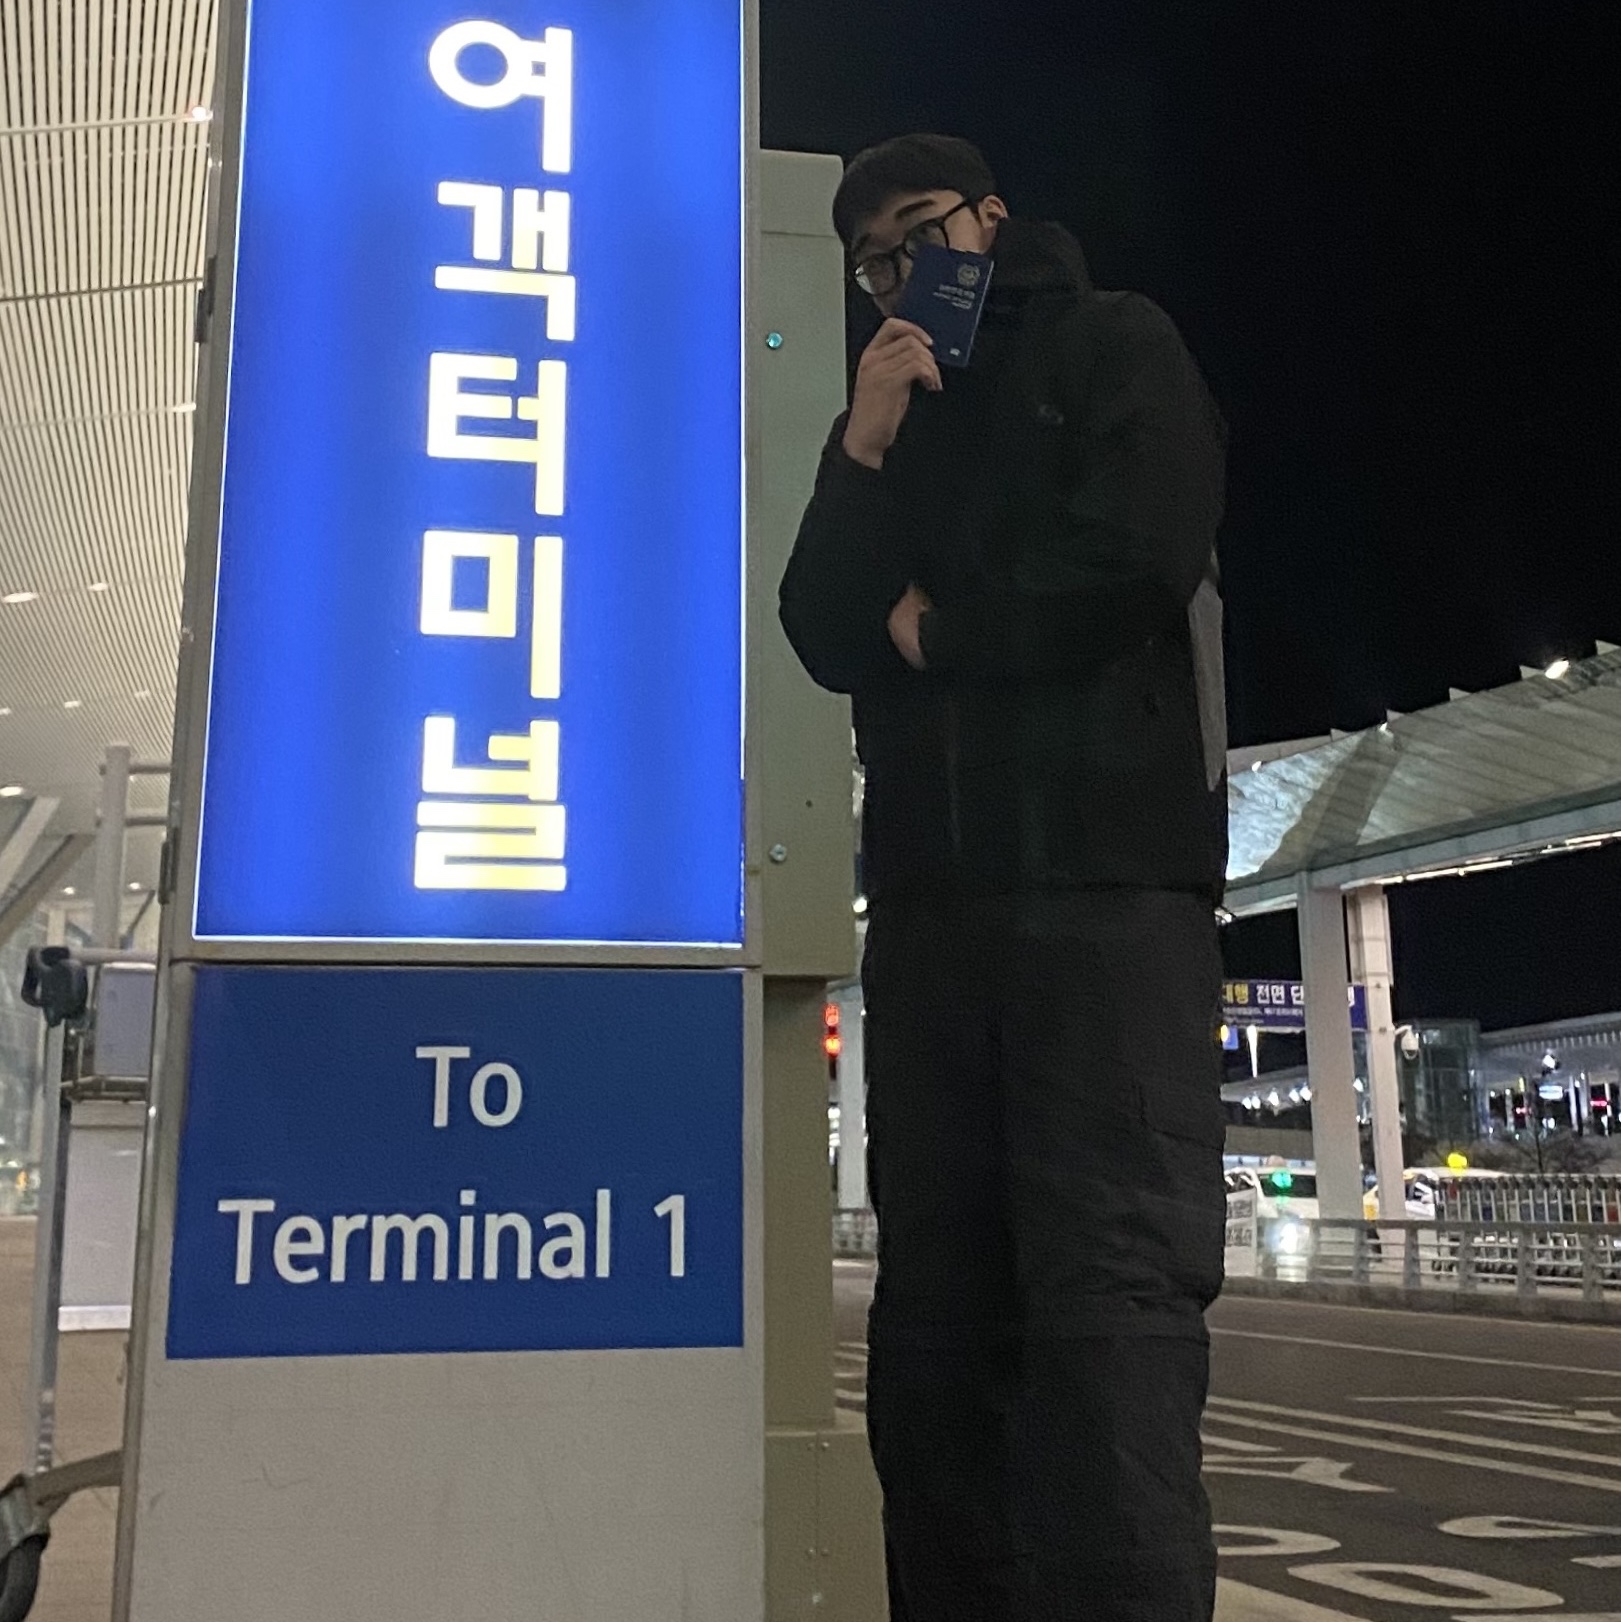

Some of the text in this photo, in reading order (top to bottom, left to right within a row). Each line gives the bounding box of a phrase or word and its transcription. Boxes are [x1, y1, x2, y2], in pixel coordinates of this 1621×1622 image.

[414, 20, 575, 891] 여객터미널
[416, 1046, 523, 1127] To
[217, 1188, 686, 1285] Terminal 1
